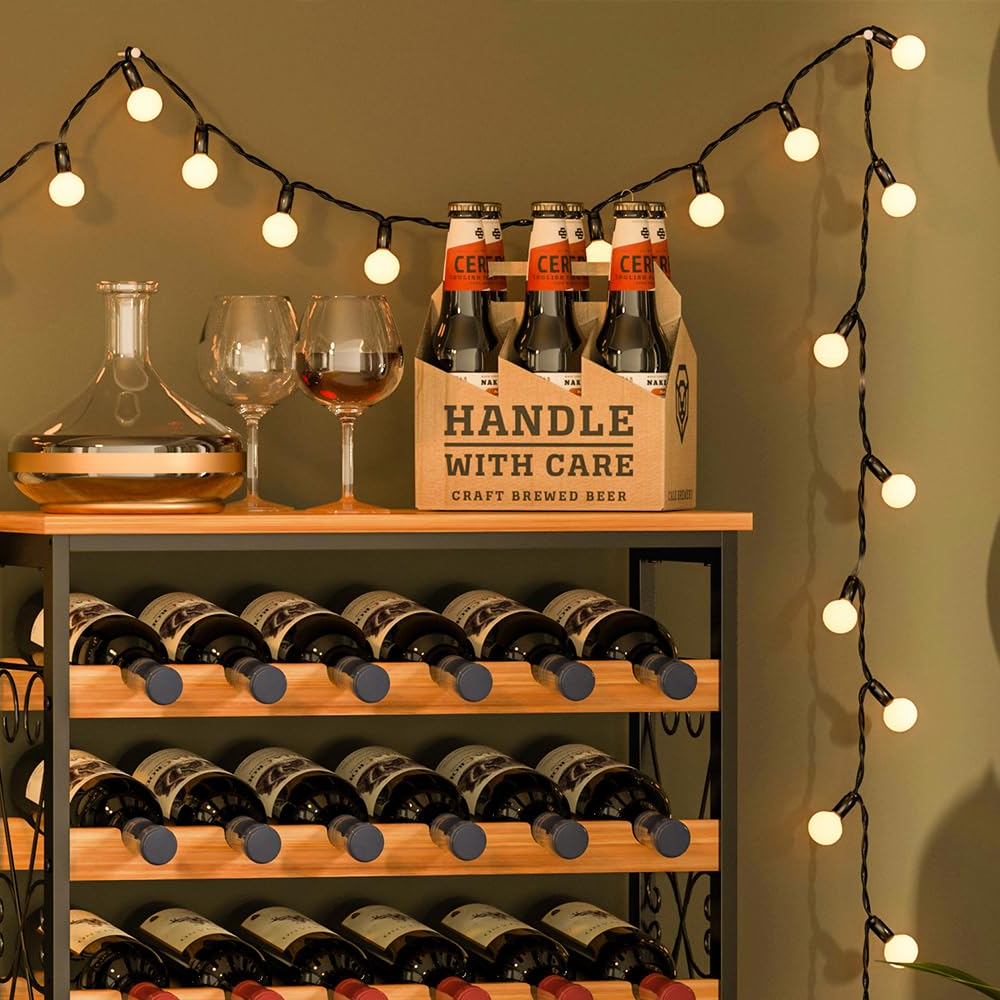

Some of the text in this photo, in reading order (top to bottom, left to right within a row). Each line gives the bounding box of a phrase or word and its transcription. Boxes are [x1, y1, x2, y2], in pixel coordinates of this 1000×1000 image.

[444, 405, 634, 437] HANDLE
[445, 453, 634, 477] WITH CARE
[452, 490, 627, 501] CRAFT BREWED BEER
